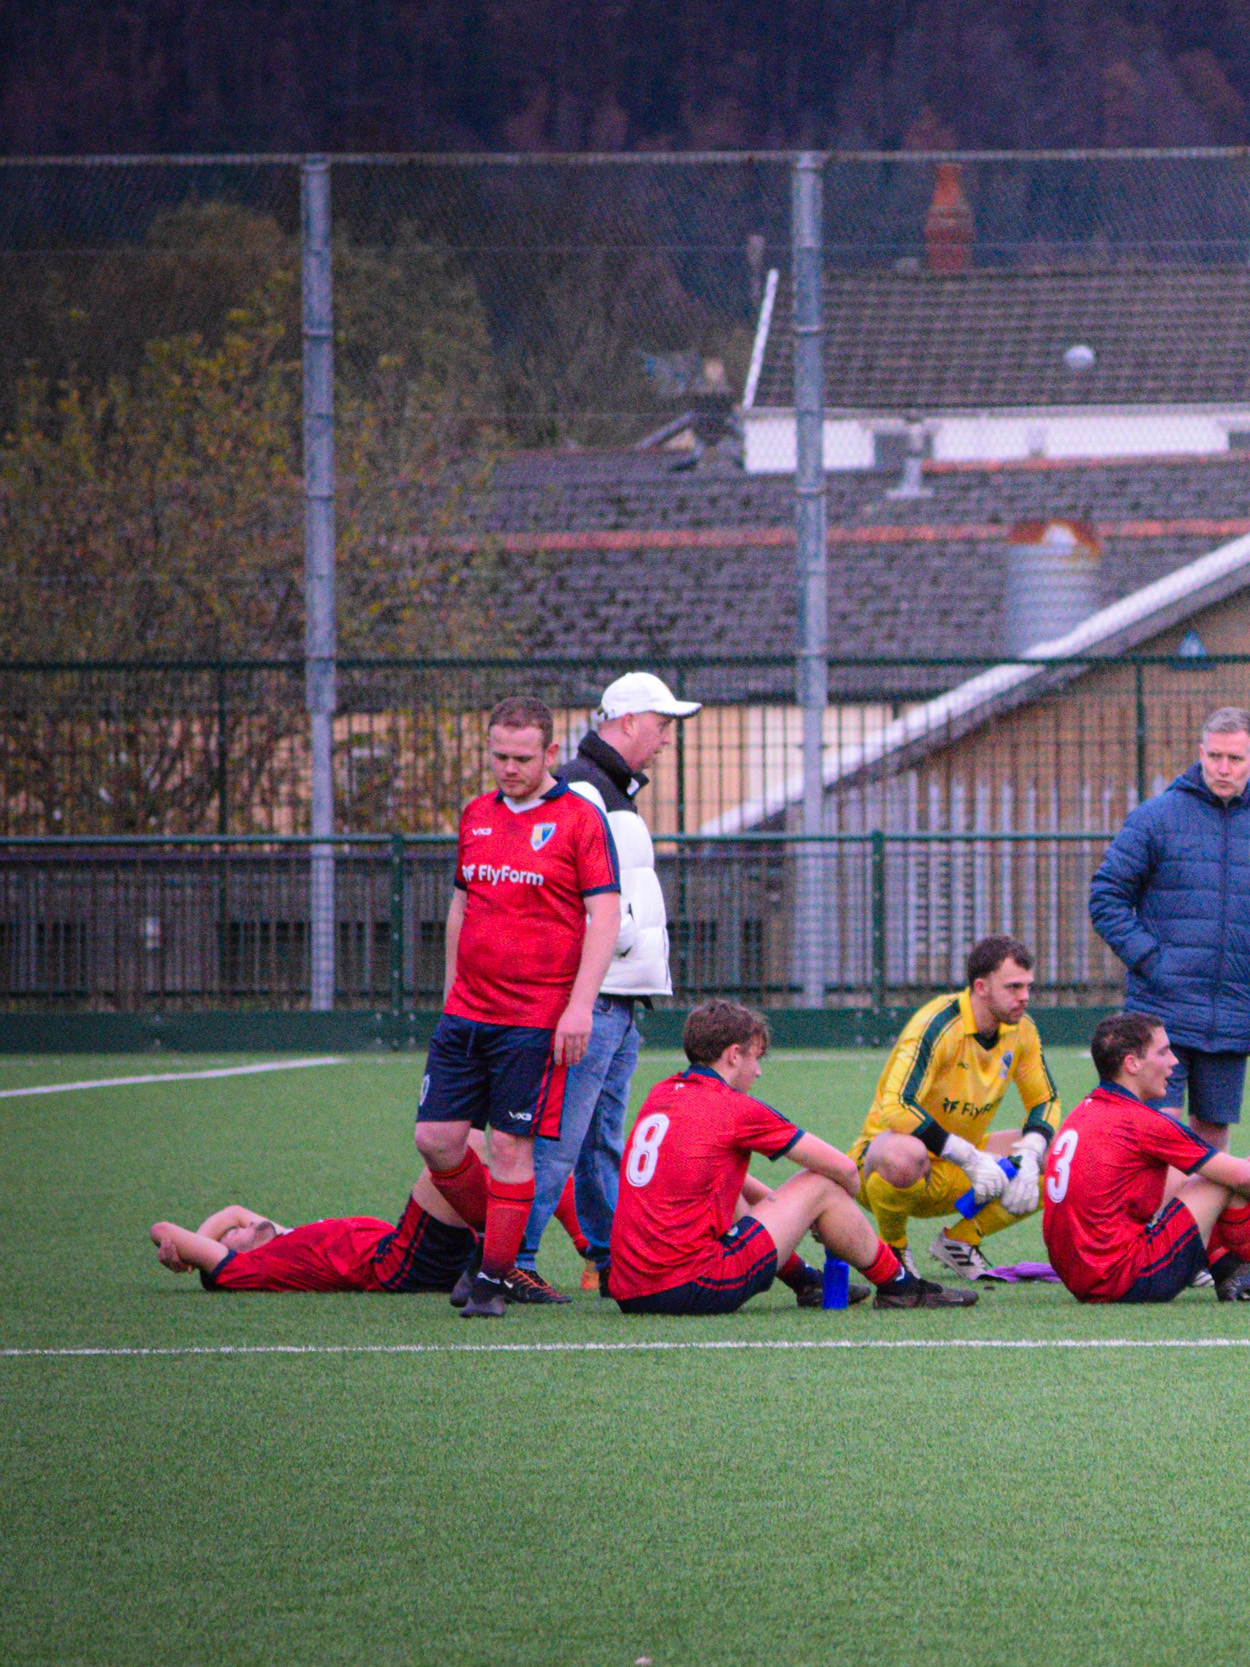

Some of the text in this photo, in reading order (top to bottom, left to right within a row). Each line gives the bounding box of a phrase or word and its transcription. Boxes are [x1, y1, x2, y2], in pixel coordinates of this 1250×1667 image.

[478, 864, 544, 886] FlyForm
[626, 1113, 670, 1188] 8
[1047, 1129, 1079, 1204] 3
